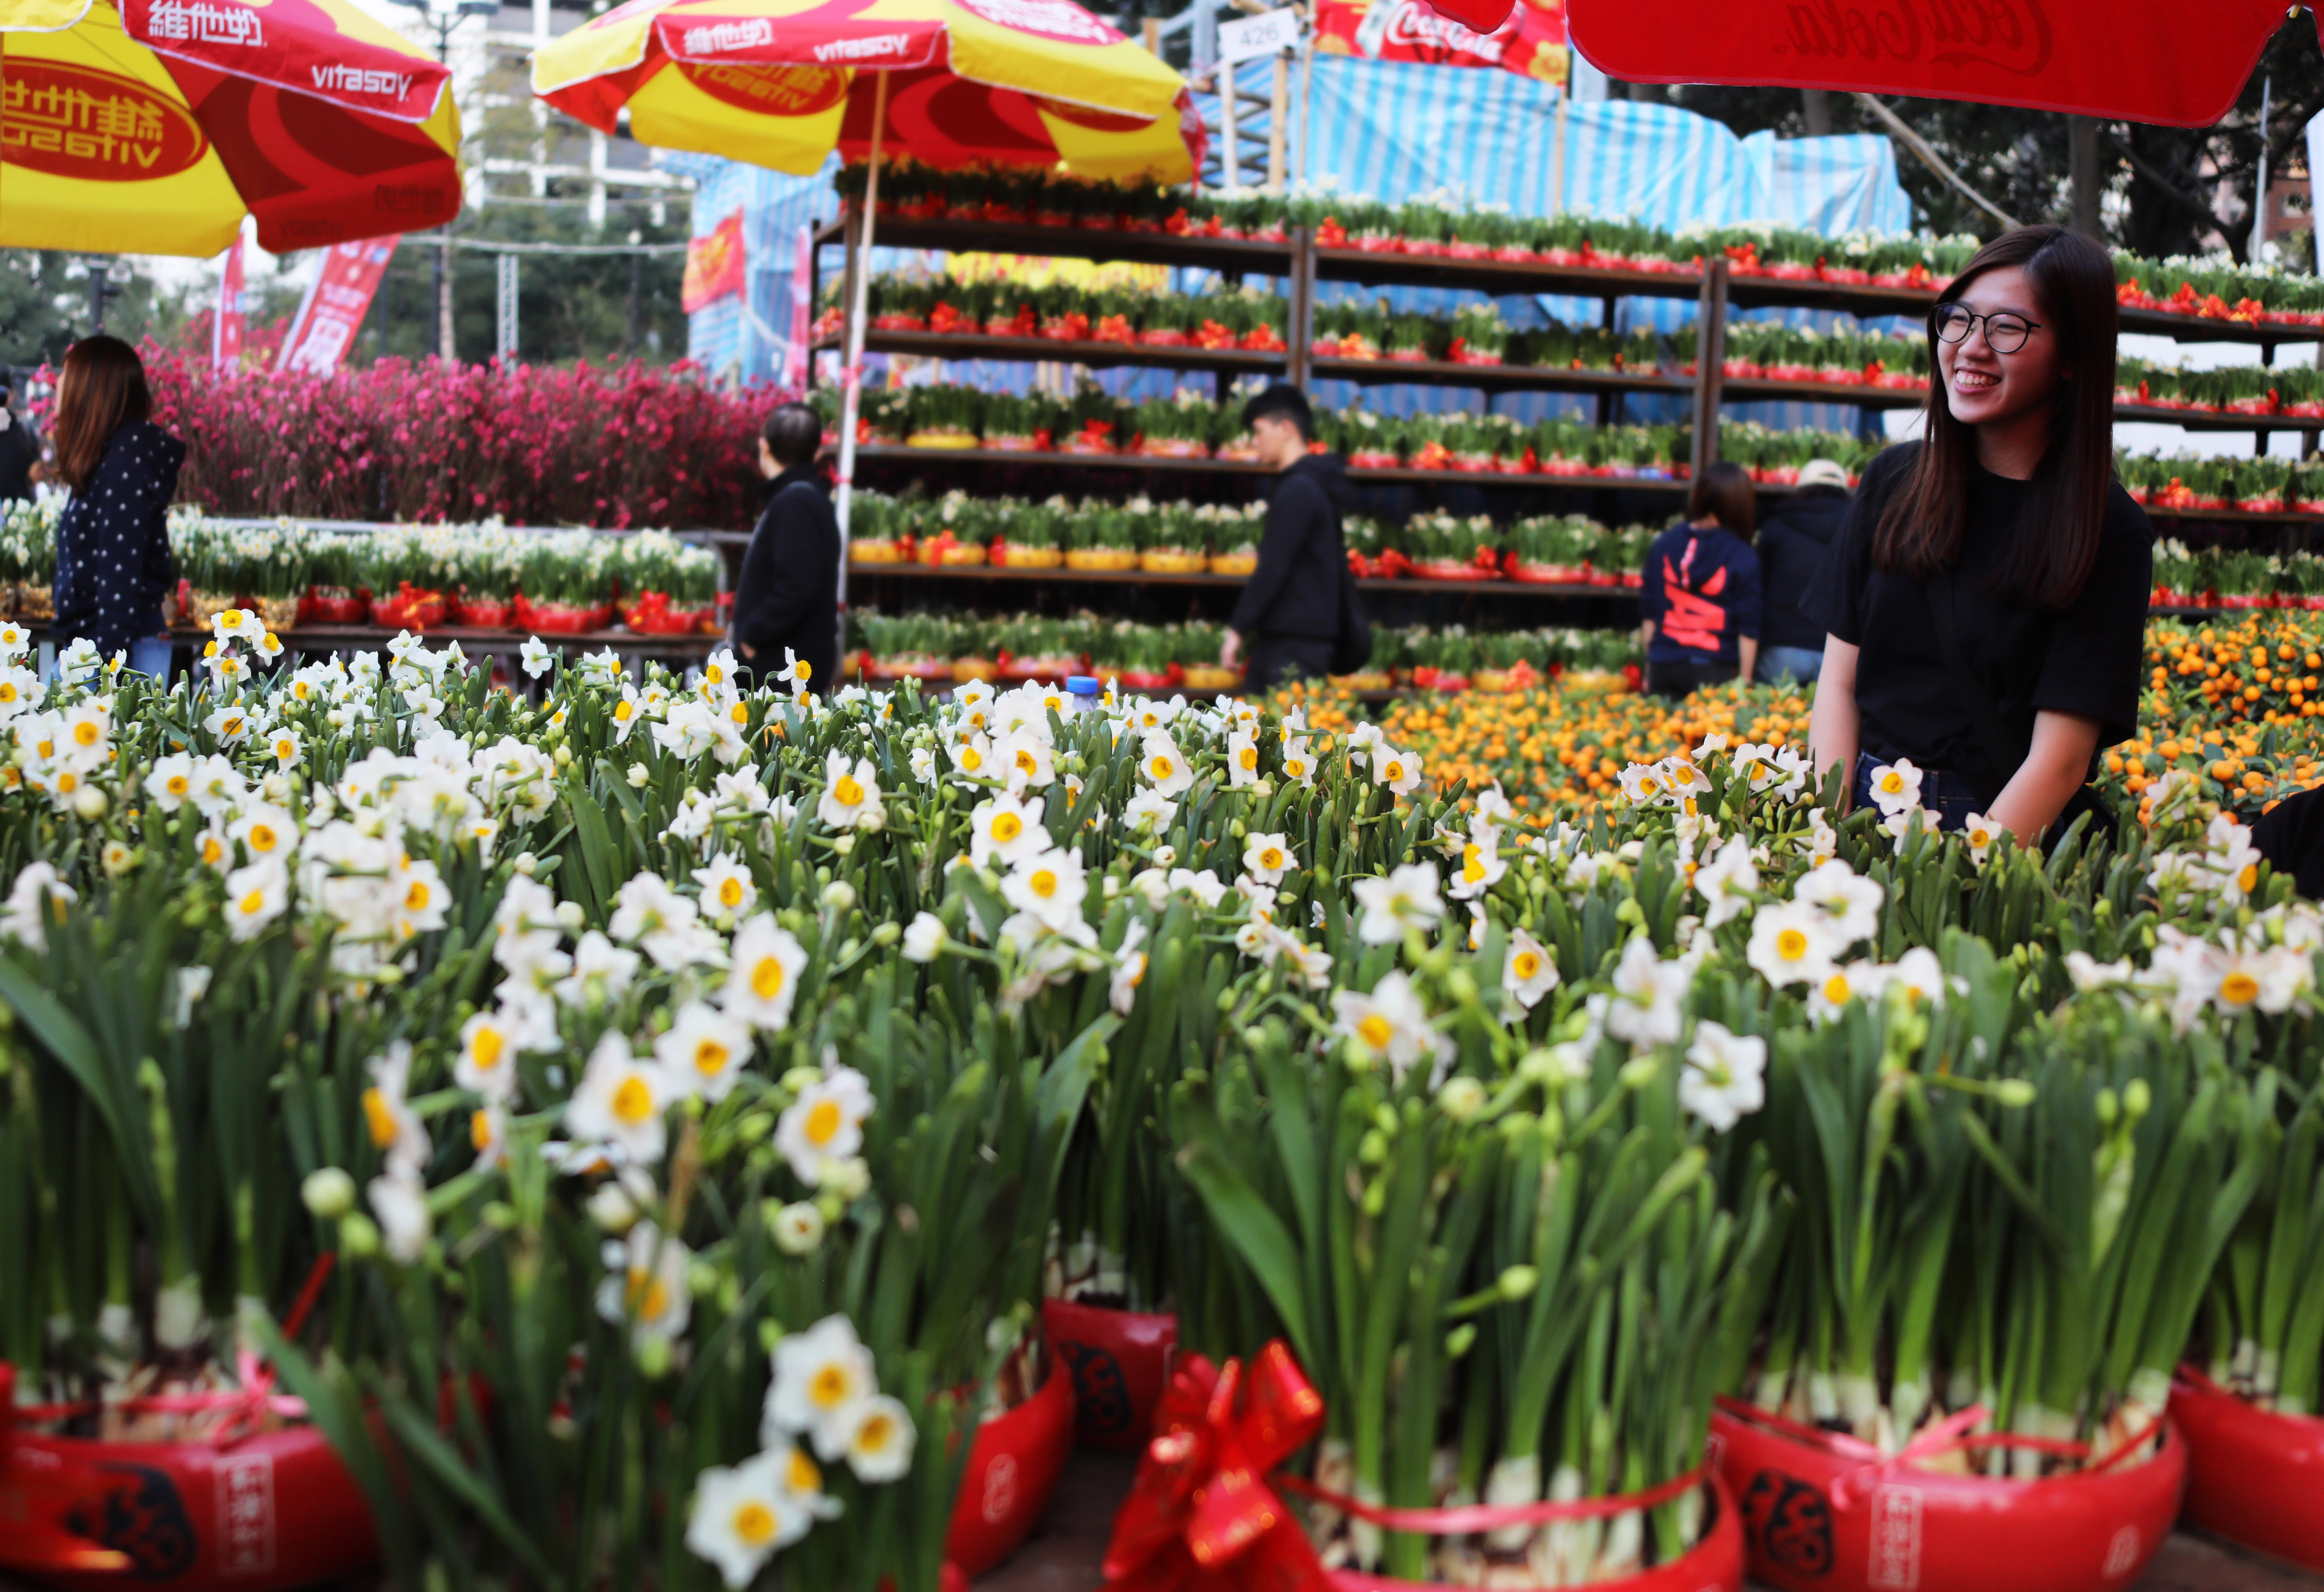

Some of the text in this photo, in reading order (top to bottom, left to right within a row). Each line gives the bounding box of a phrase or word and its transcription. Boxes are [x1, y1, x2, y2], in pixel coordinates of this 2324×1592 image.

[149, 1, 262, 47] 維他奶
[683, 18, 772, 55] 維他奶
[1240, 21, 1280, 46] 426
